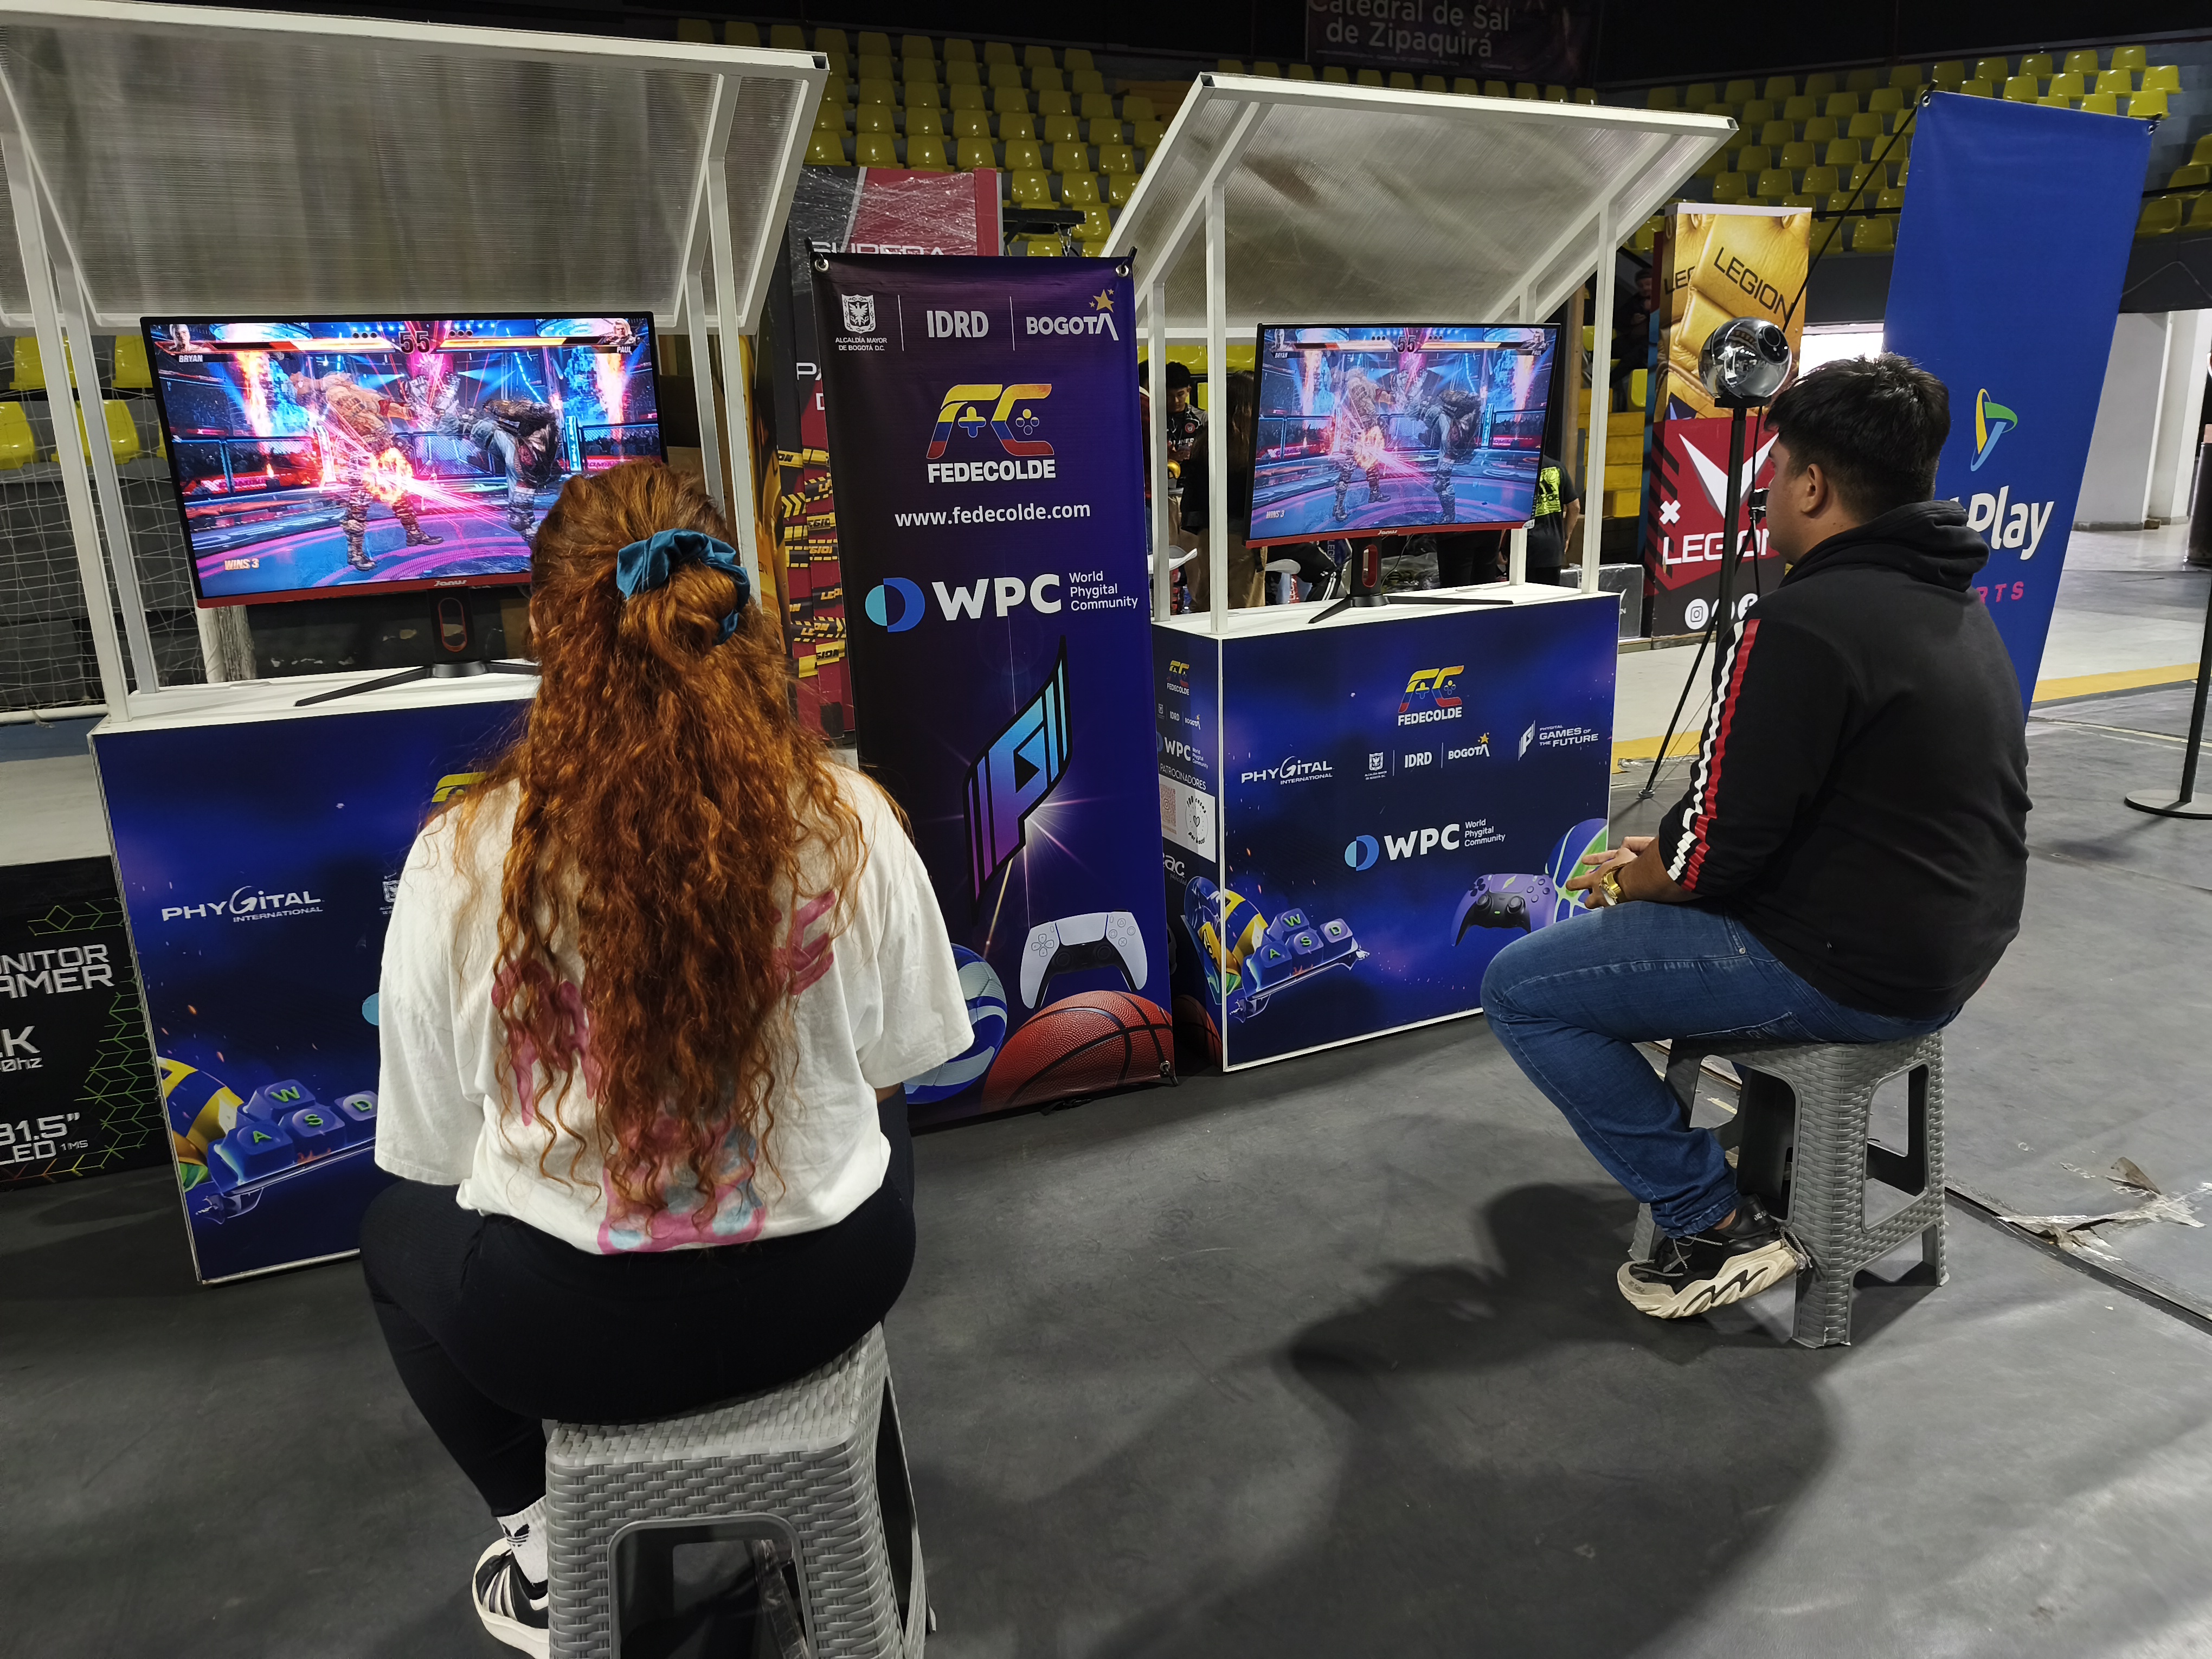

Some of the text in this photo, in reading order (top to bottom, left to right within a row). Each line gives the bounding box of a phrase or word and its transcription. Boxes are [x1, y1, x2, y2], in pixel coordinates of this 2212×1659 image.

[1433, 1, 1464, 27] de
[1473, 4, 1509, 31] Sal
[1326, 17, 1493, 58] de Zipaquirá
[1664, 265, 1696, 295] LE
[927, 311, 989, 338] IDRD
[398, 331, 430, 353] 55
[1397, 335, 1417, 353] 55
[178, 355, 203, 363] BRYAN
[927, 459, 1057, 484] FEDECOLDE
[895, 503, 1091, 527] www.fedecolde.com
[1266, 510, 1285, 519] WINS 3
[1950, 485, 2055, 560] Play
[224, 558, 260, 571] WINS 3
[931, 571, 1104, 621] WPC World
[1070, 583, 1118, 599] Phygital
[1071, 595, 1138, 612] Community
[1167, 683, 1189, 696] FEDECOLDE
[1169, 711, 1180, 721] IDRD
[1398, 706, 1462, 726] FEDECOLDE
[1539, 727, 1582, 740] GAMES
[1552, 733, 1599, 748] FUTURE
[1164, 737, 1191, 761] WPC
[1404, 751, 1432, 768] IDRD
[1160, 763, 1206, 790] PATROCINADORES
[1280, 773, 1333, 785] INTERNATIONAL
[1384, 818, 1486, 861] WPC World
[1464, 833, 1506, 847] Community
[1465, 826, 1494, 838] Phygital
[233, 906, 324, 922] INTERNATIONAL
[1283, 913, 1301, 927] W
[0, 944, 110, 975] NITOR
[0, 1025, 41, 1058] K
[271, 1086, 300, 1102] W
[252, 1099, 372, 1143] A S D
